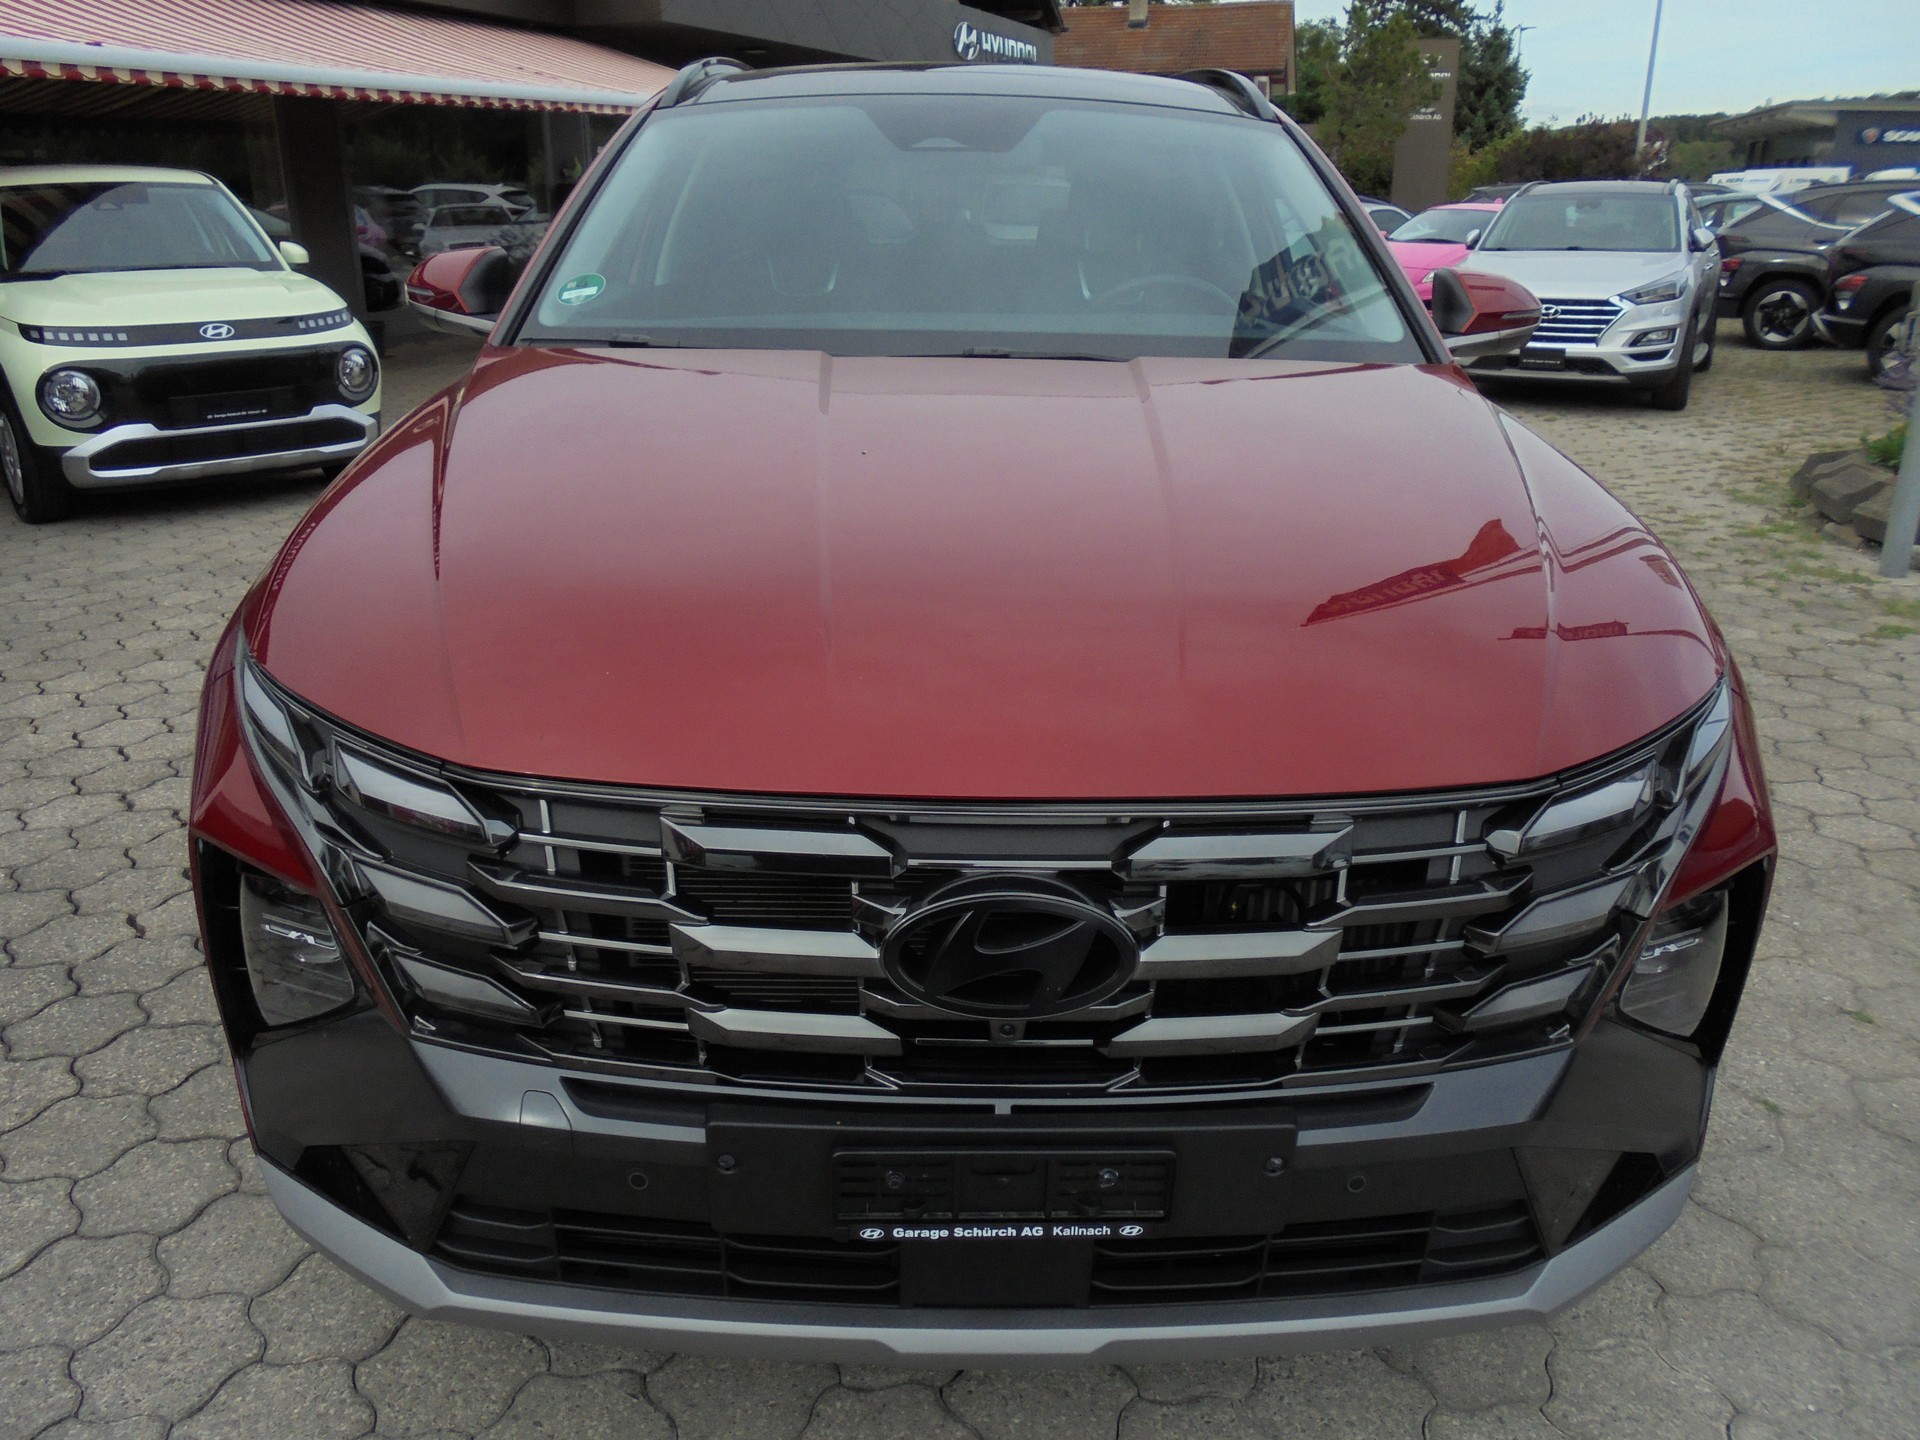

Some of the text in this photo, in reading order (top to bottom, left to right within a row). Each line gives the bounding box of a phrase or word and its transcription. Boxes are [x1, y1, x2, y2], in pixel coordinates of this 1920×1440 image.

[981, 31, 1037, 62] HYUNDAI
[892, 1225, 1111, 1239] Garage Schürch AG Kallnach
